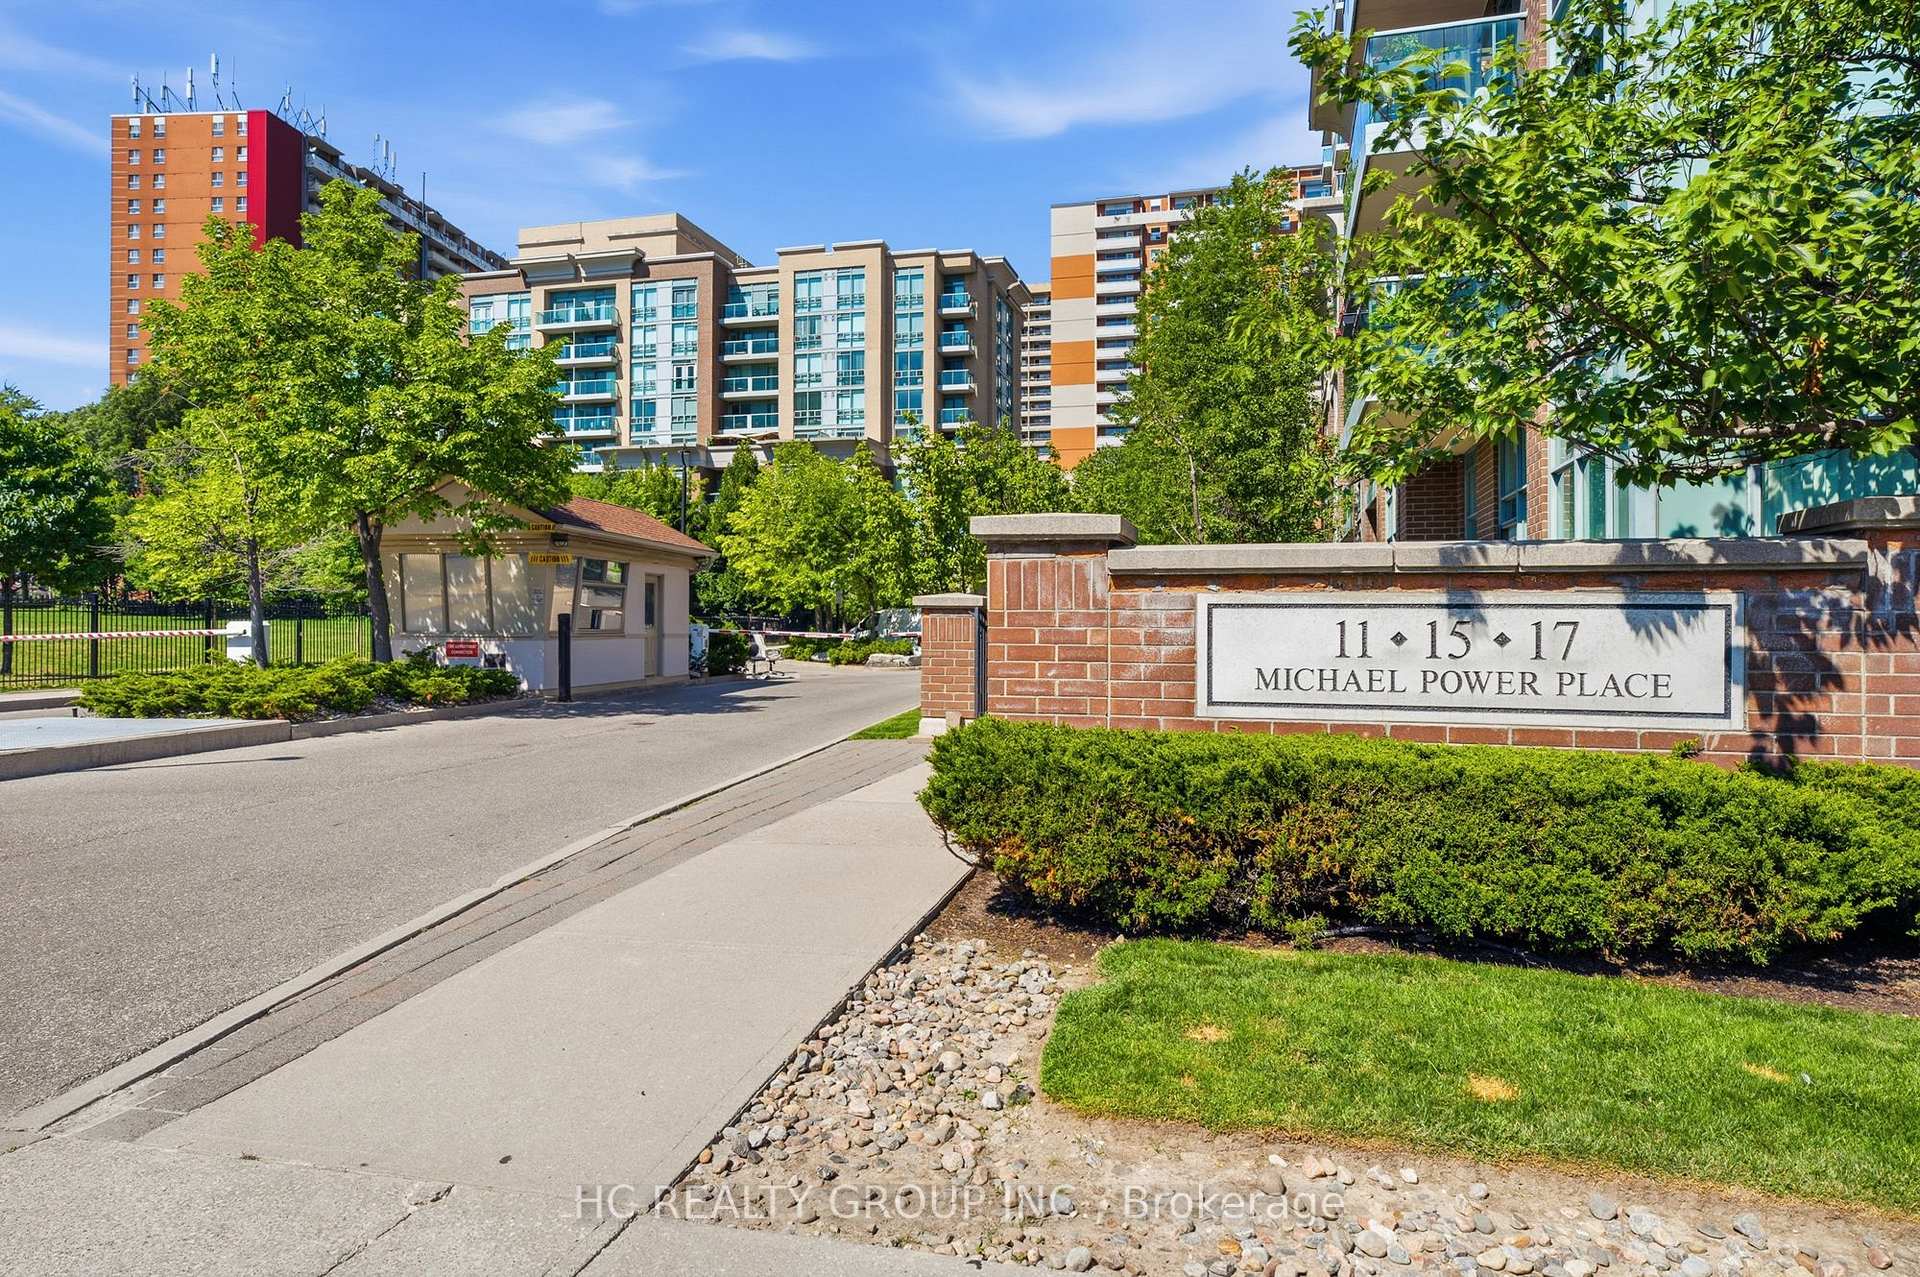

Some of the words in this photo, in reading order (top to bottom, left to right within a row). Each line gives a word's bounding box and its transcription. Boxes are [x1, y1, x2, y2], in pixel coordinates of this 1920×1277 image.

[1335, 619, 1371, 659] 11
[1425, 619, 1472, 661] 15
[1530, 620, 1580, 662] 17
[1254, 667, 1407, 694] MICHAEL
[1420, 669, 1542, 697] POWER
[1556, 672, 1673, 700] PLACE
